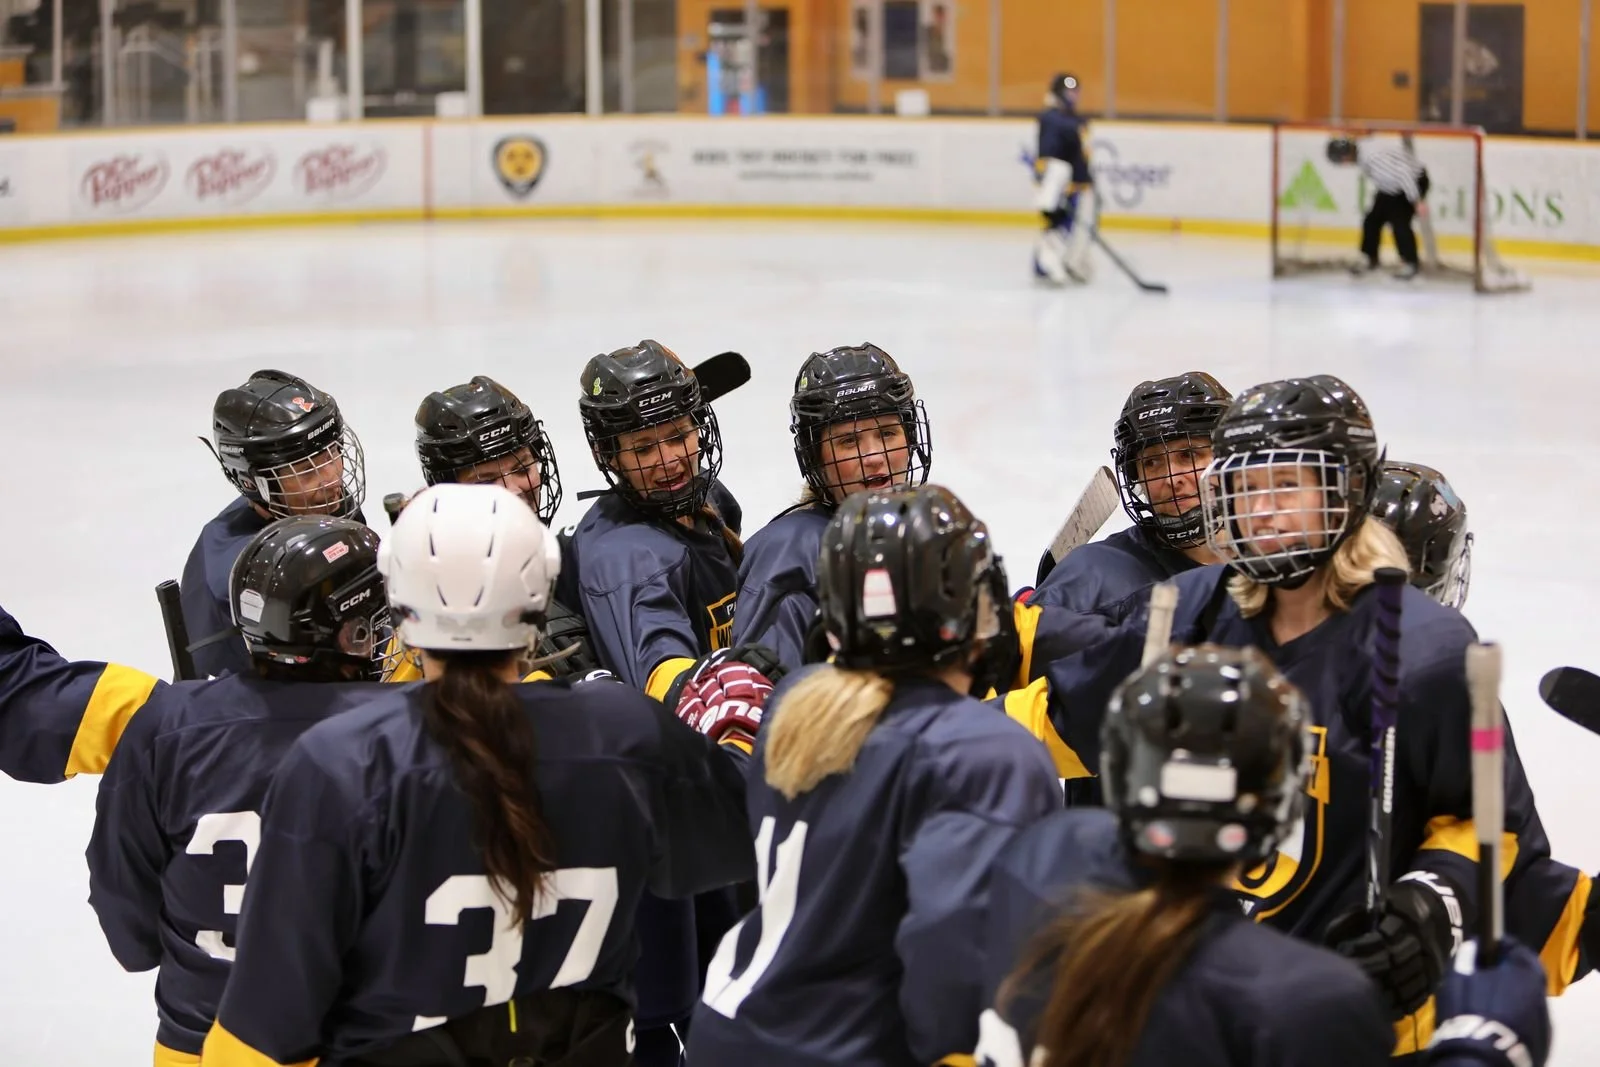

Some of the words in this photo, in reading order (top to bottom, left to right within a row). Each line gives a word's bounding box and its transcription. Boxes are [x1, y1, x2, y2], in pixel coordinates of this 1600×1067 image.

[638, 390, 673, 408] CCM
[836, 384, 877, 398] BAUER
[1137, 406, 1174, 420] CCM
[306, 417, 335, 441] BAUER
[479, 424, 512, 442] CCM
[1166, 526, 1200, 540] CCM
[338, 588, 371, 612] CCM
[424, 867, 619, 1010] 37
